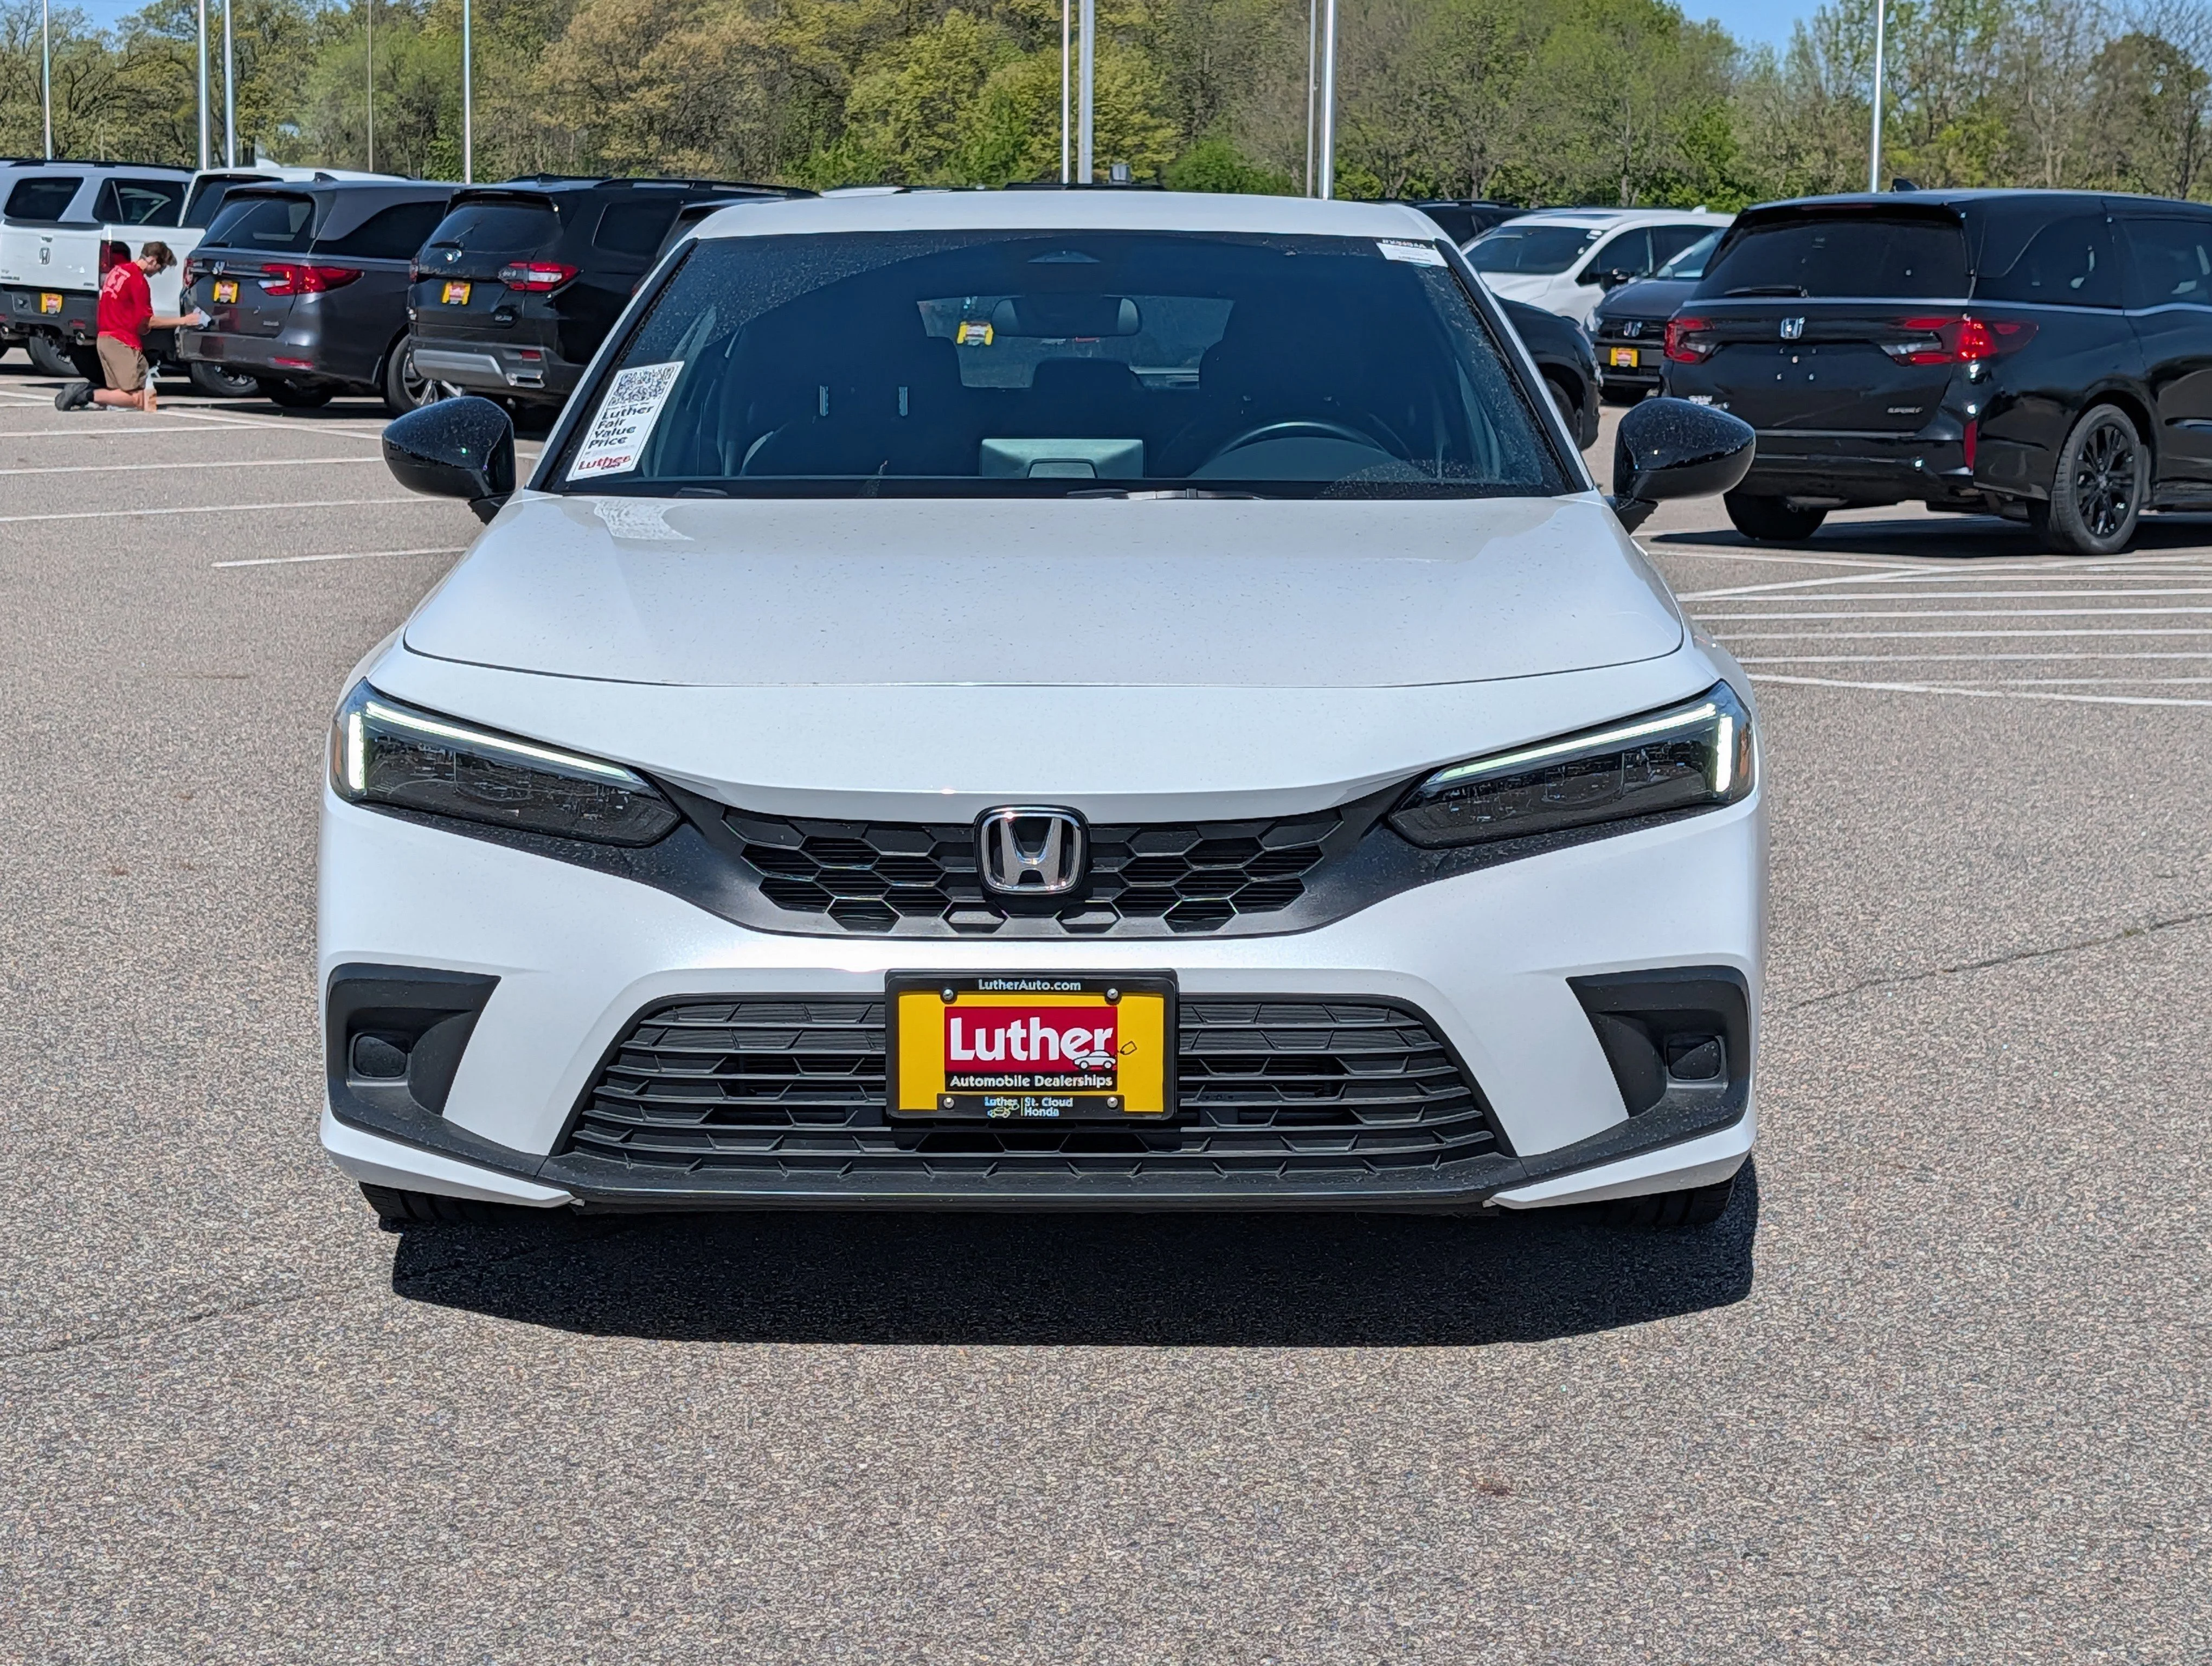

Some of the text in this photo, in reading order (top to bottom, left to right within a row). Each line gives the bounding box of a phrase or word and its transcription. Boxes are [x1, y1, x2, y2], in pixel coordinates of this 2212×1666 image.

[602, 406, 654, 420] Luther
[597, 418, 626, 430] Fair
[595, 427, 636, 438] Value
[588, 437, 627, 449] Price
[978, 979, 1081, 990] LutherAuto.com
[950, 1017, 1114, 1061] Luther
[950, 1074, 1113, 1088] Automobile Dealerships
[1024, 1097, 1073, 1107] St. Cloud
[1024, 1107, 1059, 1117] Honda
